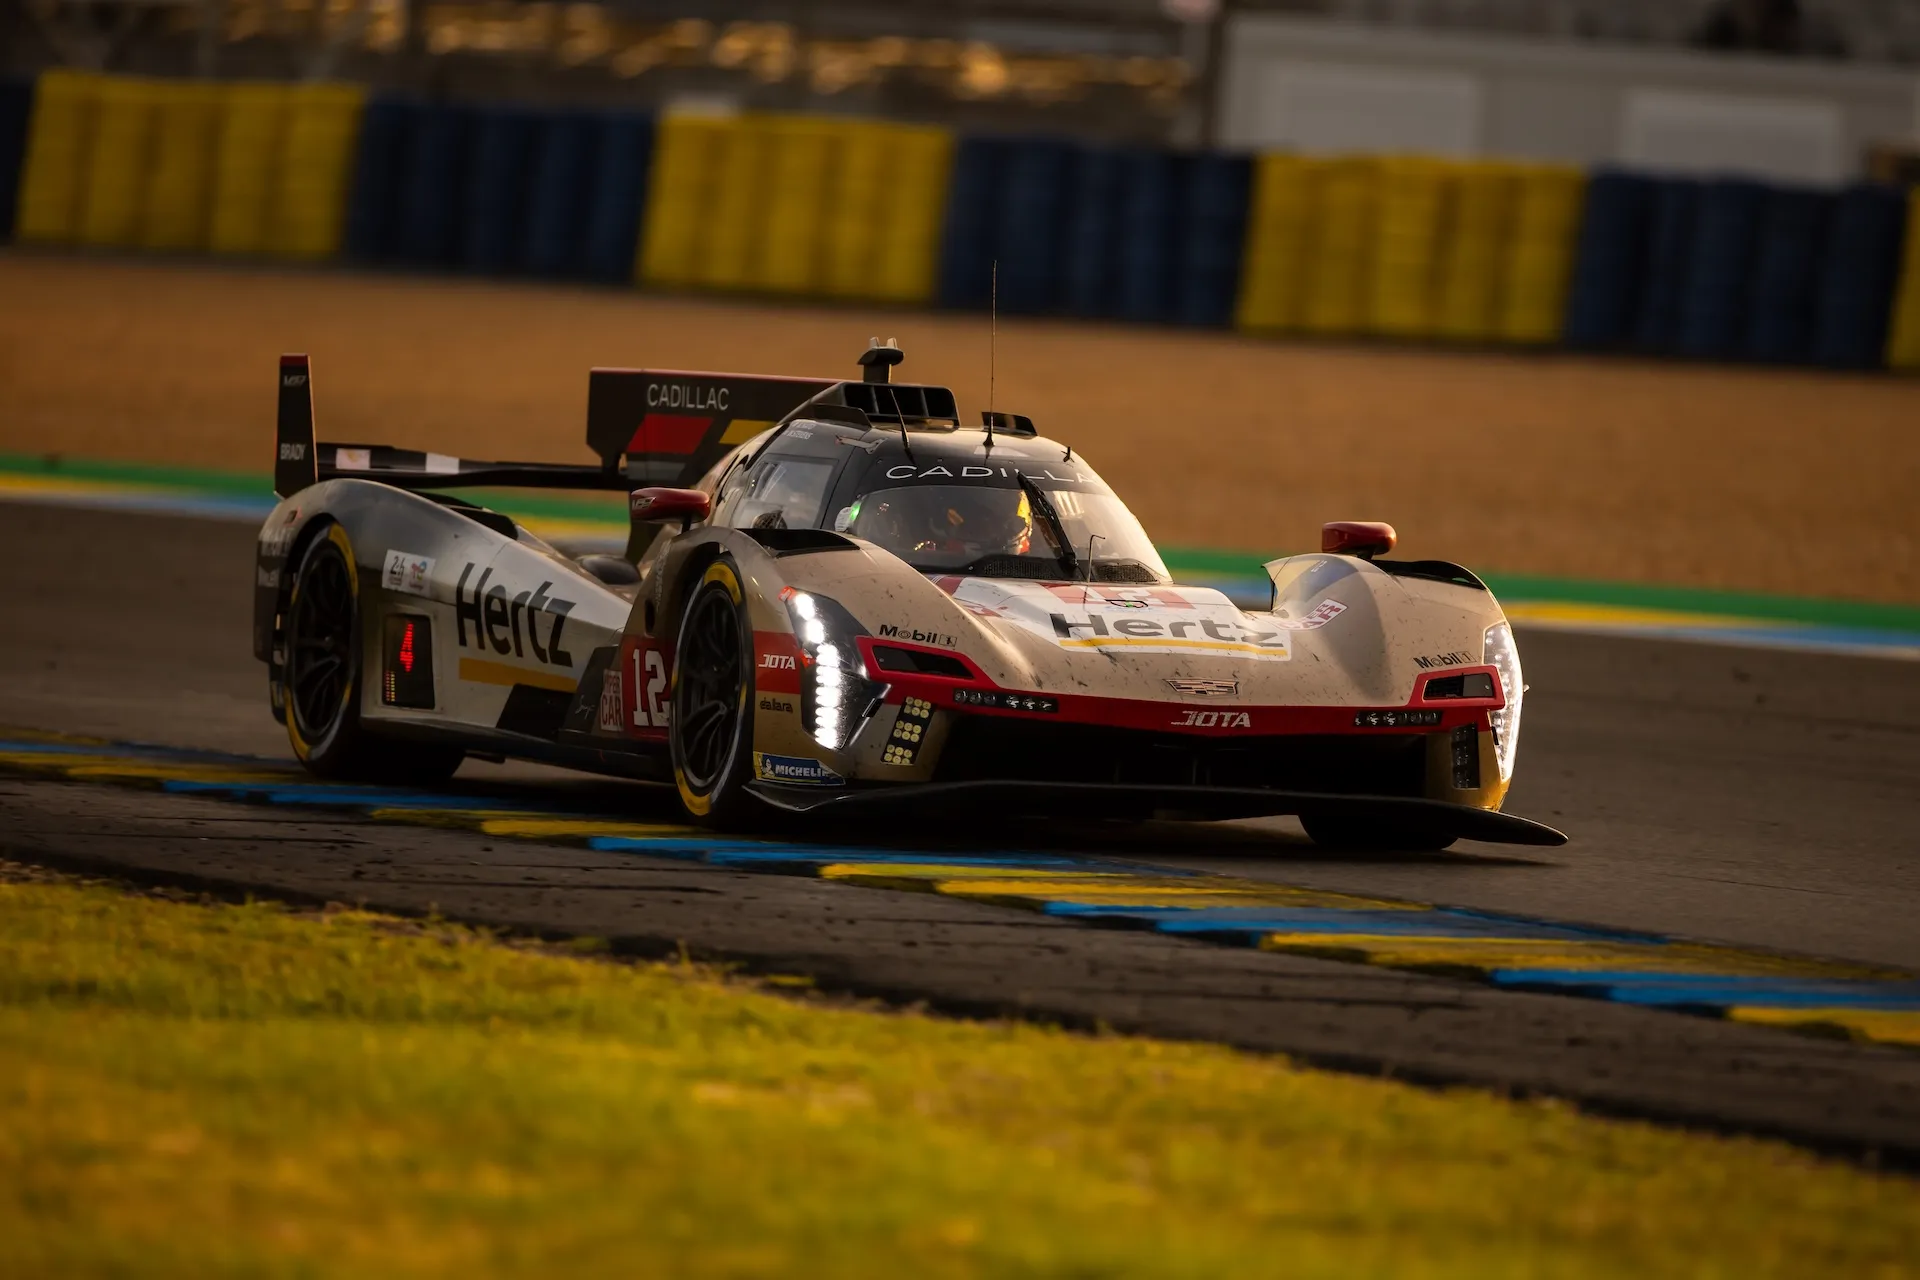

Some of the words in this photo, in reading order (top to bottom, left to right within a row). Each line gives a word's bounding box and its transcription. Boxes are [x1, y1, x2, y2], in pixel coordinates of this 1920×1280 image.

[647, 384, 729, 411] CADILLAC
[280, 443, 306, 460] BRADY
[886, 465, 1099, 484] CADILLA
[456, 562, 577, 668] Hertz
[879, 624, 938, 644] Mobil
[1049, 613, 1284, 648] Hertz
[758, 654, 796, 670] JOTA
[1413, 652, 1463, 669] Mobil
[632, 648, 670, 728] 12
[601, 694, 623, 727] CAR
[1170, 711, 1251, 728] JOTA
